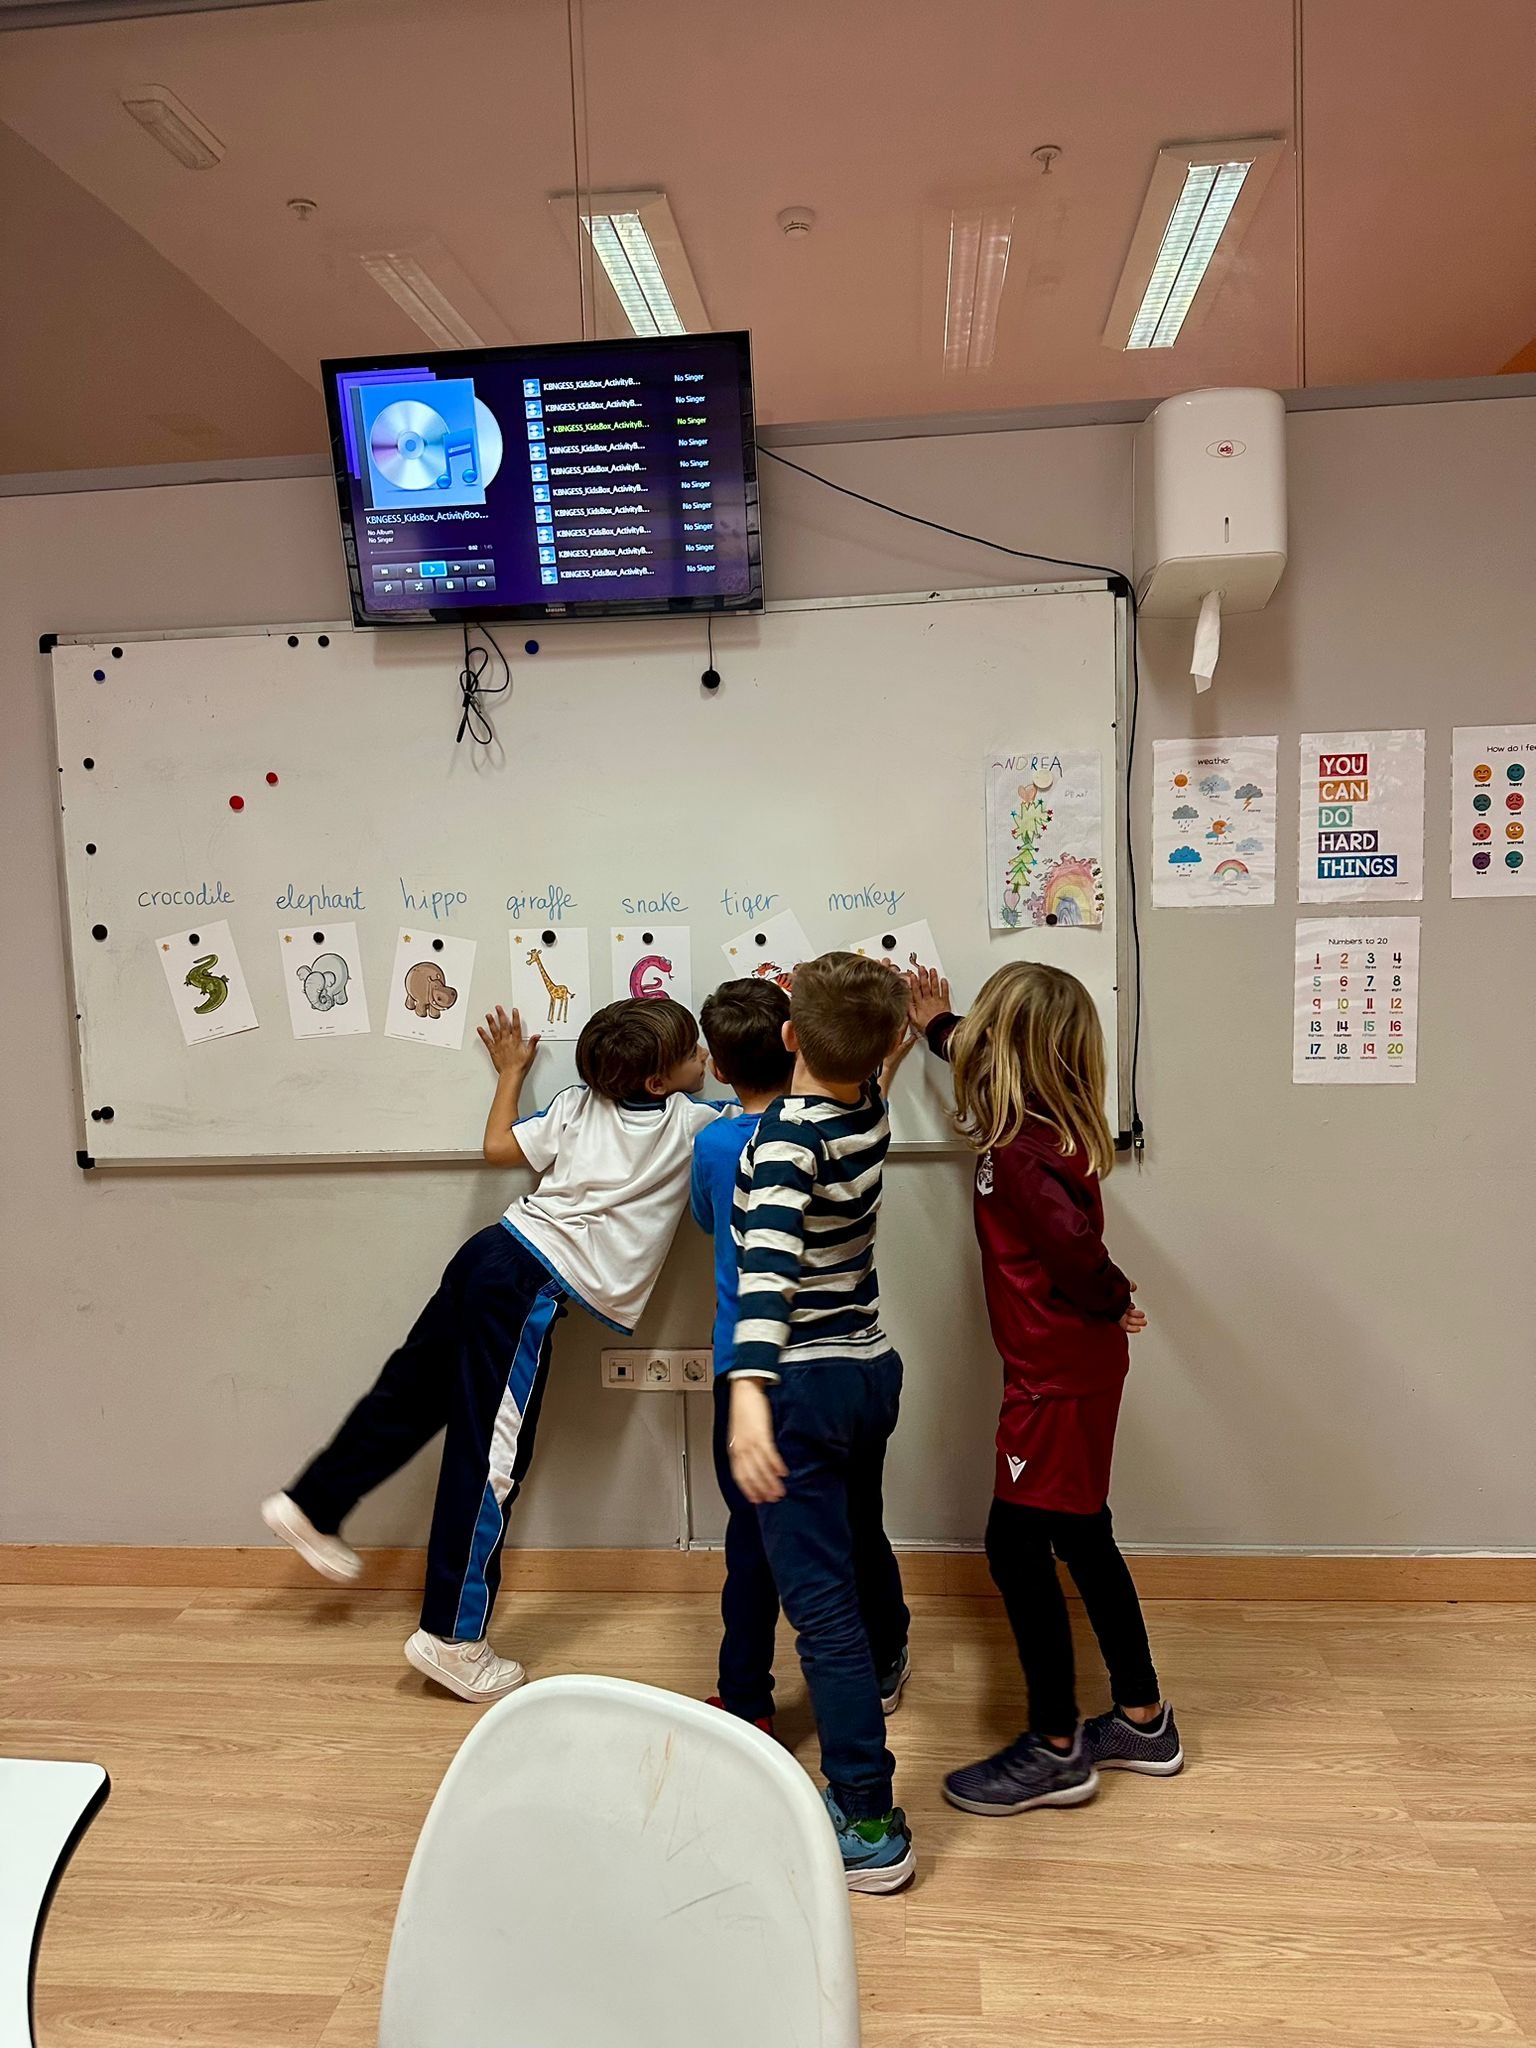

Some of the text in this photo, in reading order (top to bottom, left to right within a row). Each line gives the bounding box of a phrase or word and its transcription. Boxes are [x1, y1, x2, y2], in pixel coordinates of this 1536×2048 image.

[674, 374, 704, 382] No Singer
[686, 396, 706, 404] Singer
[688, 417, 706, 425] Singer
[688, 438, 708, 446] Singer
[690, 460, 709, 468] Singer
[691, 481, 710, 489] Singer
[692, 502, 712, 510] Singer
[694, 523, 713, 531] Singer
[696, 544, 714, 552] Singer
[697, 564, 716, 572] Singer
[1198, 757, 1230, 765] weather
[1322, 756, 1364, 774] YOU
[1322, 782, 1364, 800] CAN
[1322, 809, 1350, 826] DO
[1321, 833, 1375, 851] HARD
[1321, 858, 1394, 876] THINGS
[138, 882, 234, 907] crocodile
[276, 884, 366, 915] elephant
[400, 877, 467, 919] hippo
[506, 885, 578, 920] giraffe
[721, 888, 780, 918] tiger
[1316, 954, 1320, 964] 1
[1340, 953, 1348, 964] 2
[1367, 952, 1374, 964] 3
[1393, 952, 1402, 964] 4
[1314, 976, 1321, 986] 5
[1340, 976, 1348, 986] 6
[1367, 976, 1374, 986] 7
[1393, 975, 1400, 986] 8
[1313, 998, 1320, 1009] 9
[1338, 998, 1348, 1009] 10
[1367, 998, 1372, 1009] 11
[1391, 998, 1402, 1008] 12
[1311, 1021, 1322, 1032] 13
[1337, 1021, 1348, 1032] 14
[1364, 1021, 1374, 1032] 15
[1390, 1021, 1401, 1031] 16
[1311, 1044, 1321, 1054] 17
[1337, 1044, 1348, 1054] 18
[1364, 1044, 1374, 1054] 19
[1387, 1044, 1403, 1054] 20
